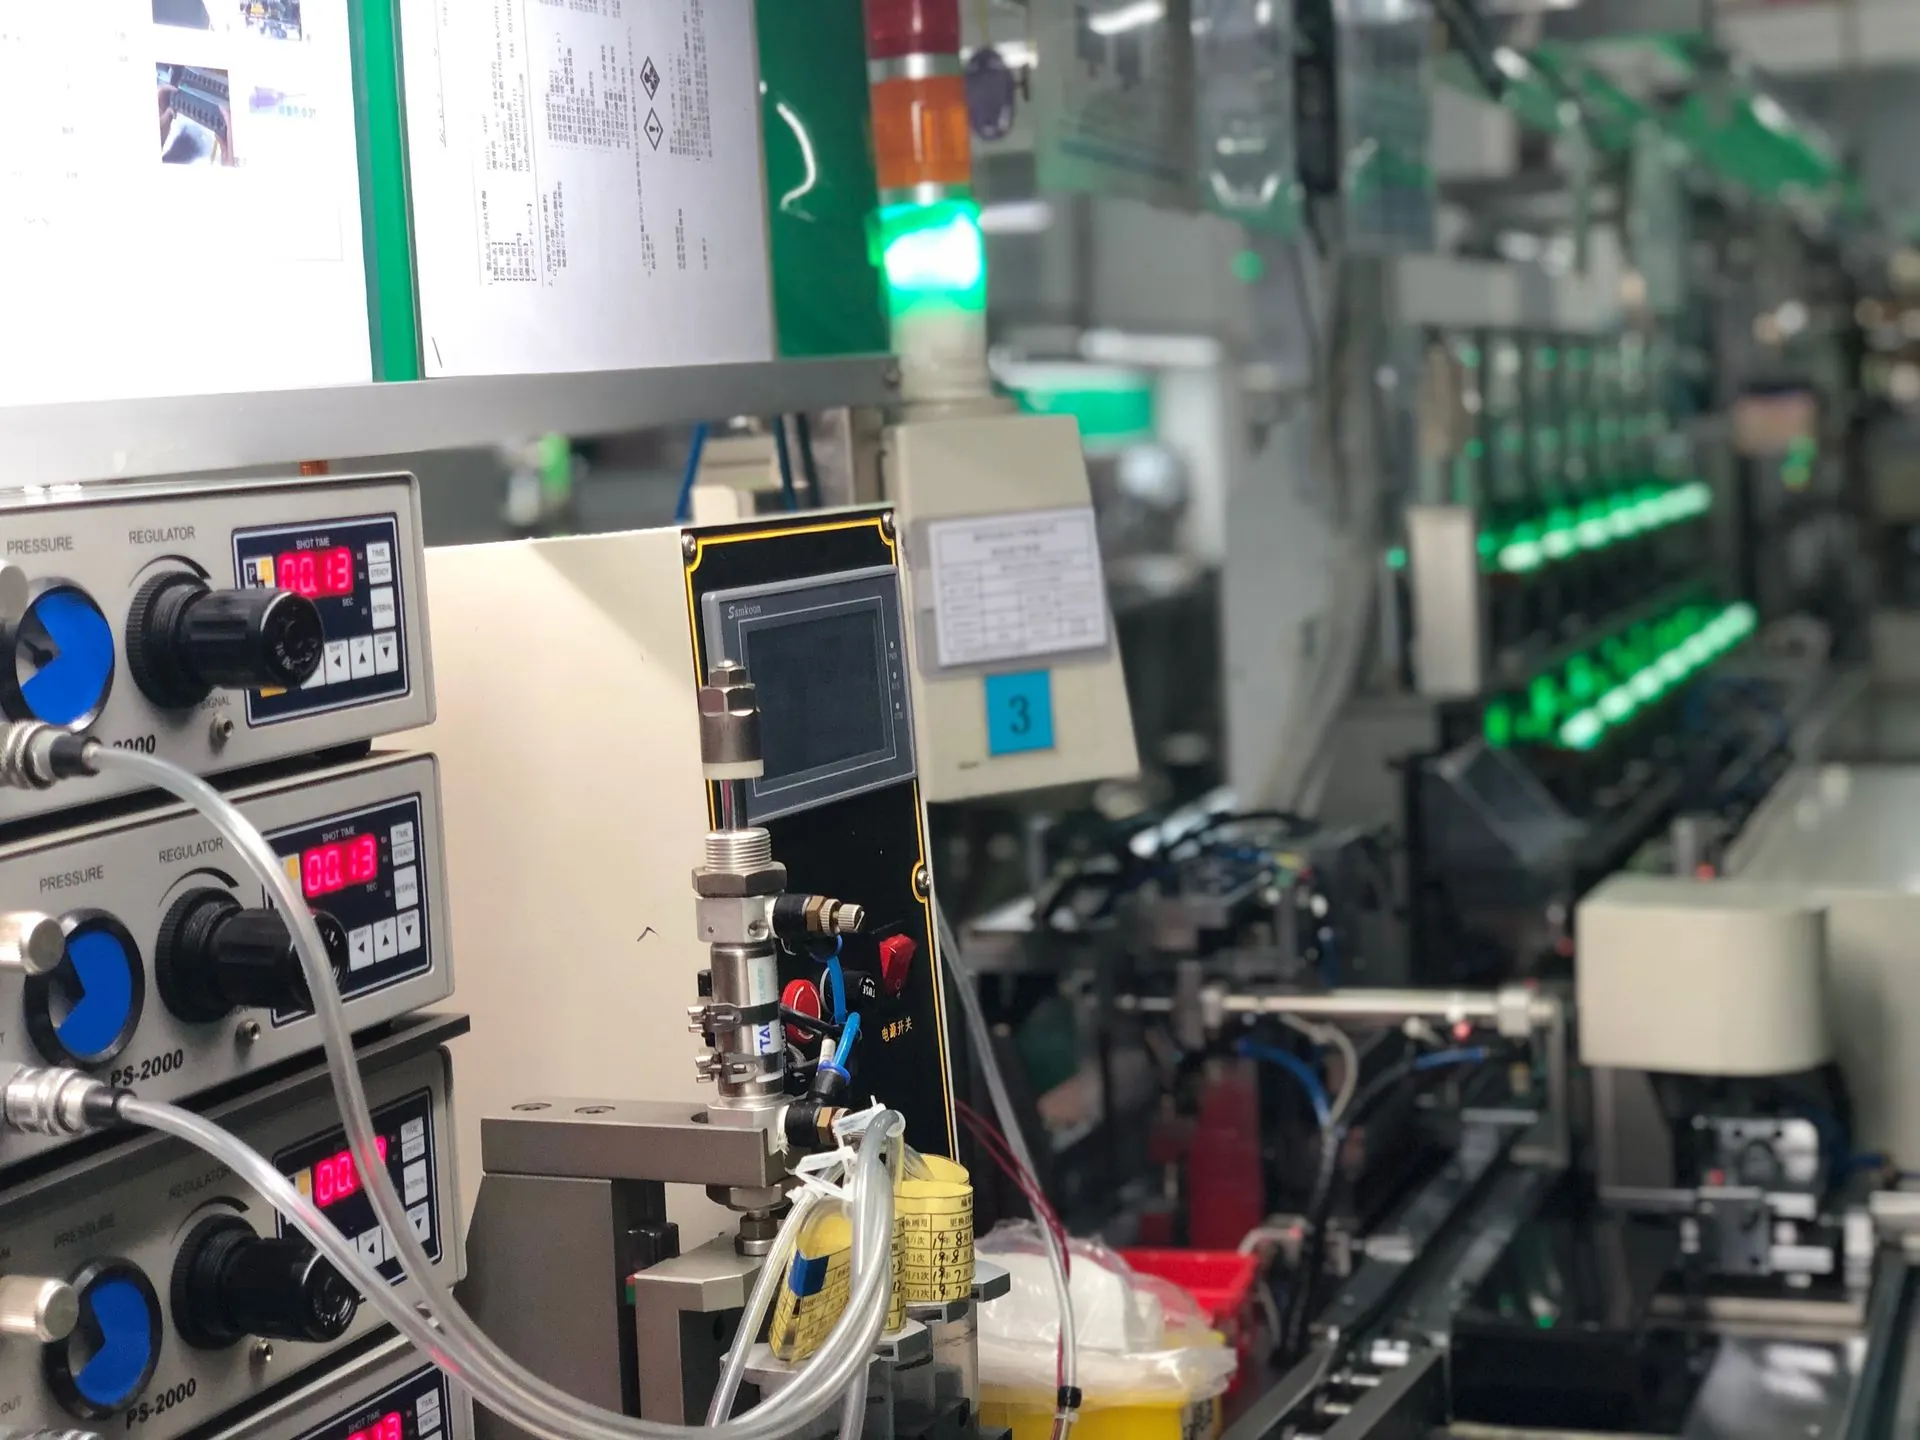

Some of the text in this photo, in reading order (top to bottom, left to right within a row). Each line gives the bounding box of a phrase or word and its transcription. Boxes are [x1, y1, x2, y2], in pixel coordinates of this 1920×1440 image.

[6, 536, 74, 555] PRESSURE
[128, 526, 195, 544] REGULATOR
[296, 537, 330, 549] SHOT TIME
[1009, 693, 1031, 736] 3
[322, 825, 355, 843] SHOT TIME
[159, 837, 224, 864] REGULATOR
[39, 865, 104, 893] PRESSURE
[881, 1016, 912, 1042] 电源开关
[110, 1049, 184, 1088] PS-2000
[169, 1166, 232, 1200] REGULATOR
[54, 1211, 116, 1249] PRESSURE
[126, 1377, 197, 1430] PS-2000
